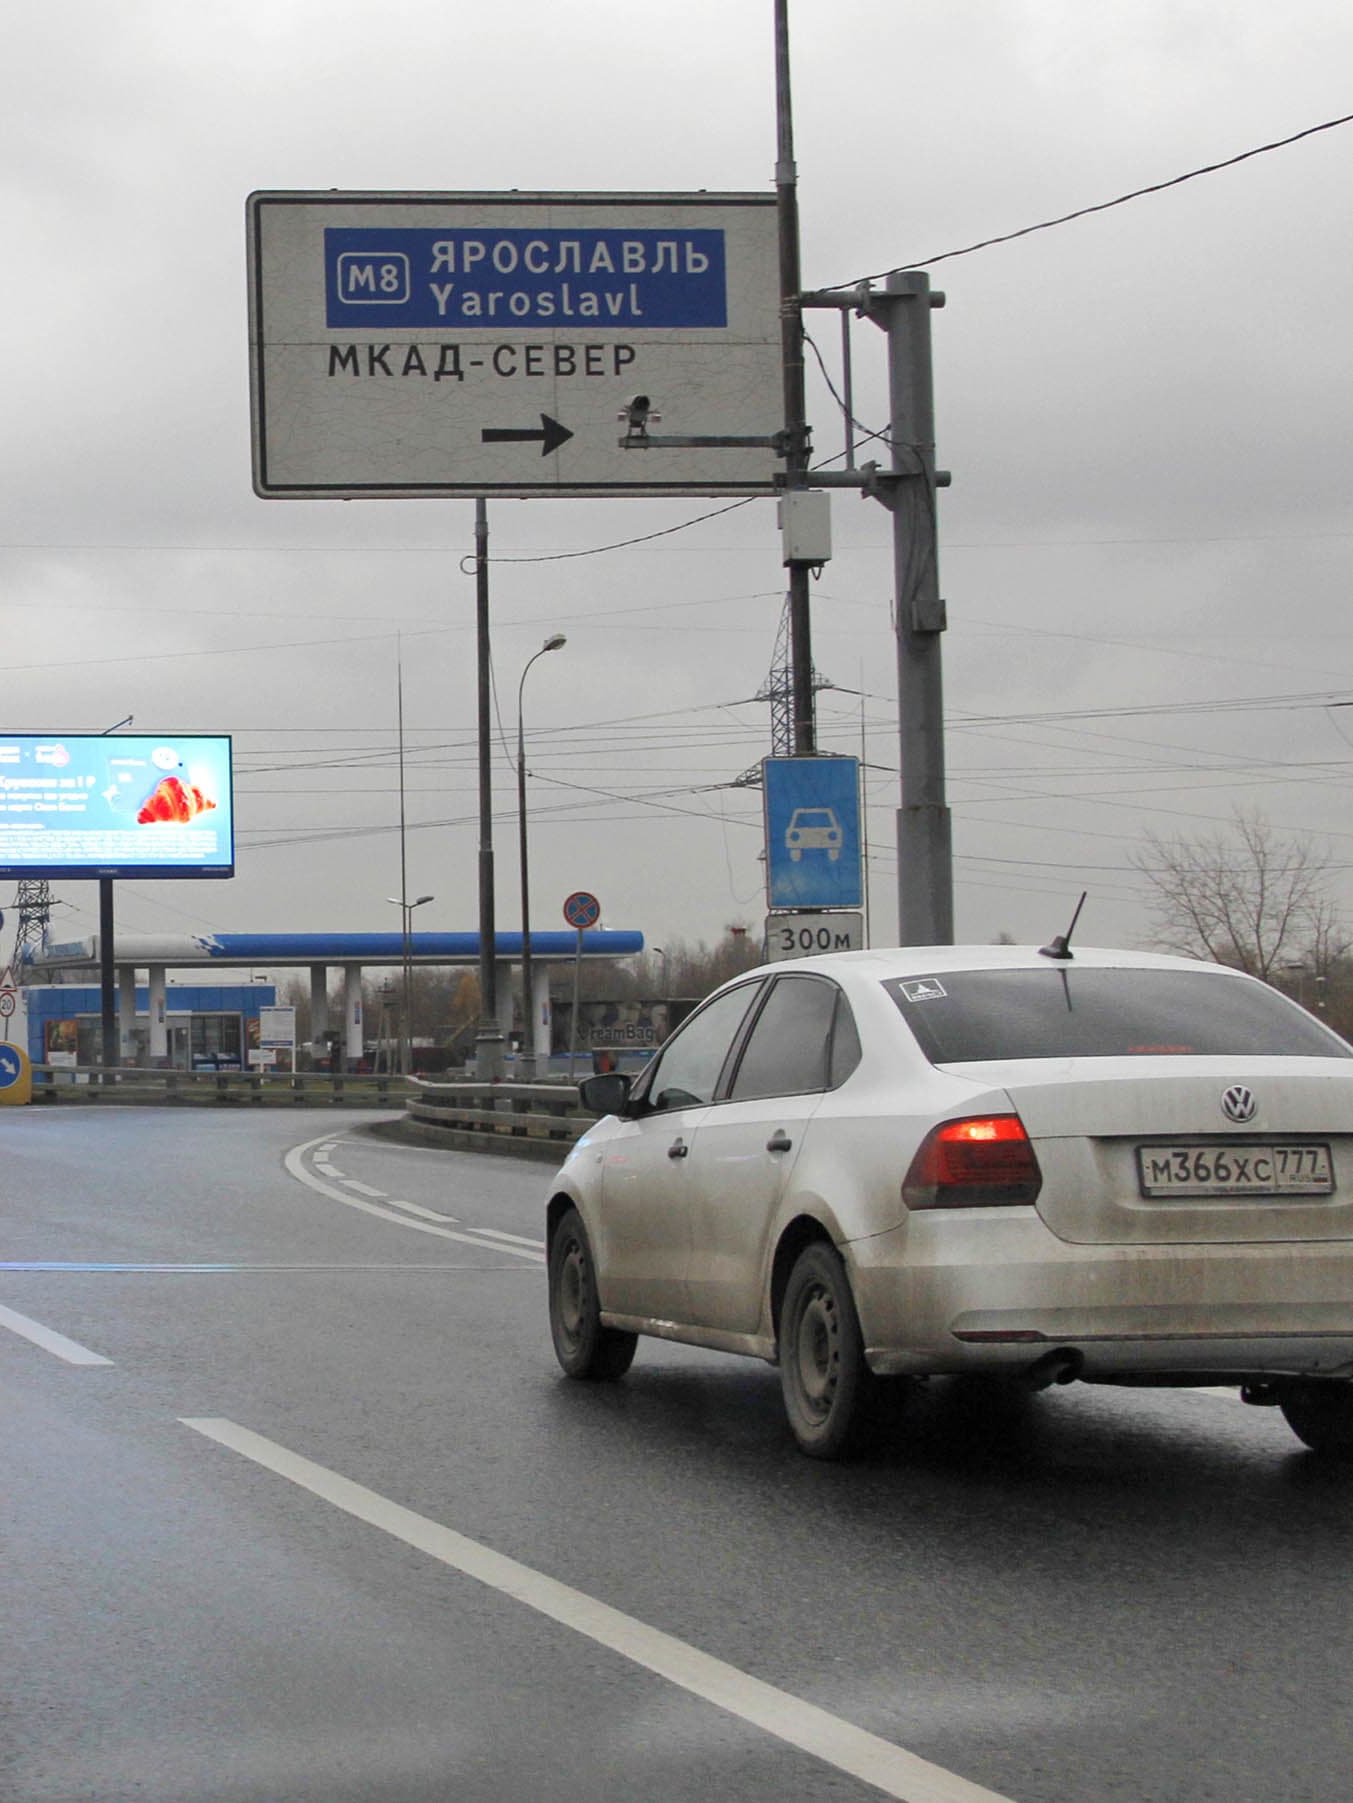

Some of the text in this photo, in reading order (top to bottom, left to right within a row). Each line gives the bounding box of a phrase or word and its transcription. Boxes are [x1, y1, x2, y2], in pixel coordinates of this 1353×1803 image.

[429, 239, 711, 275] ЯРОСЛАВЛЬ
[429, 283, 644, 317] Yaroslavl
[328, 344, 638, 382] МКАД-СЕВЕР
[1151, 1150, 1319, 1183] М366ХС 777
